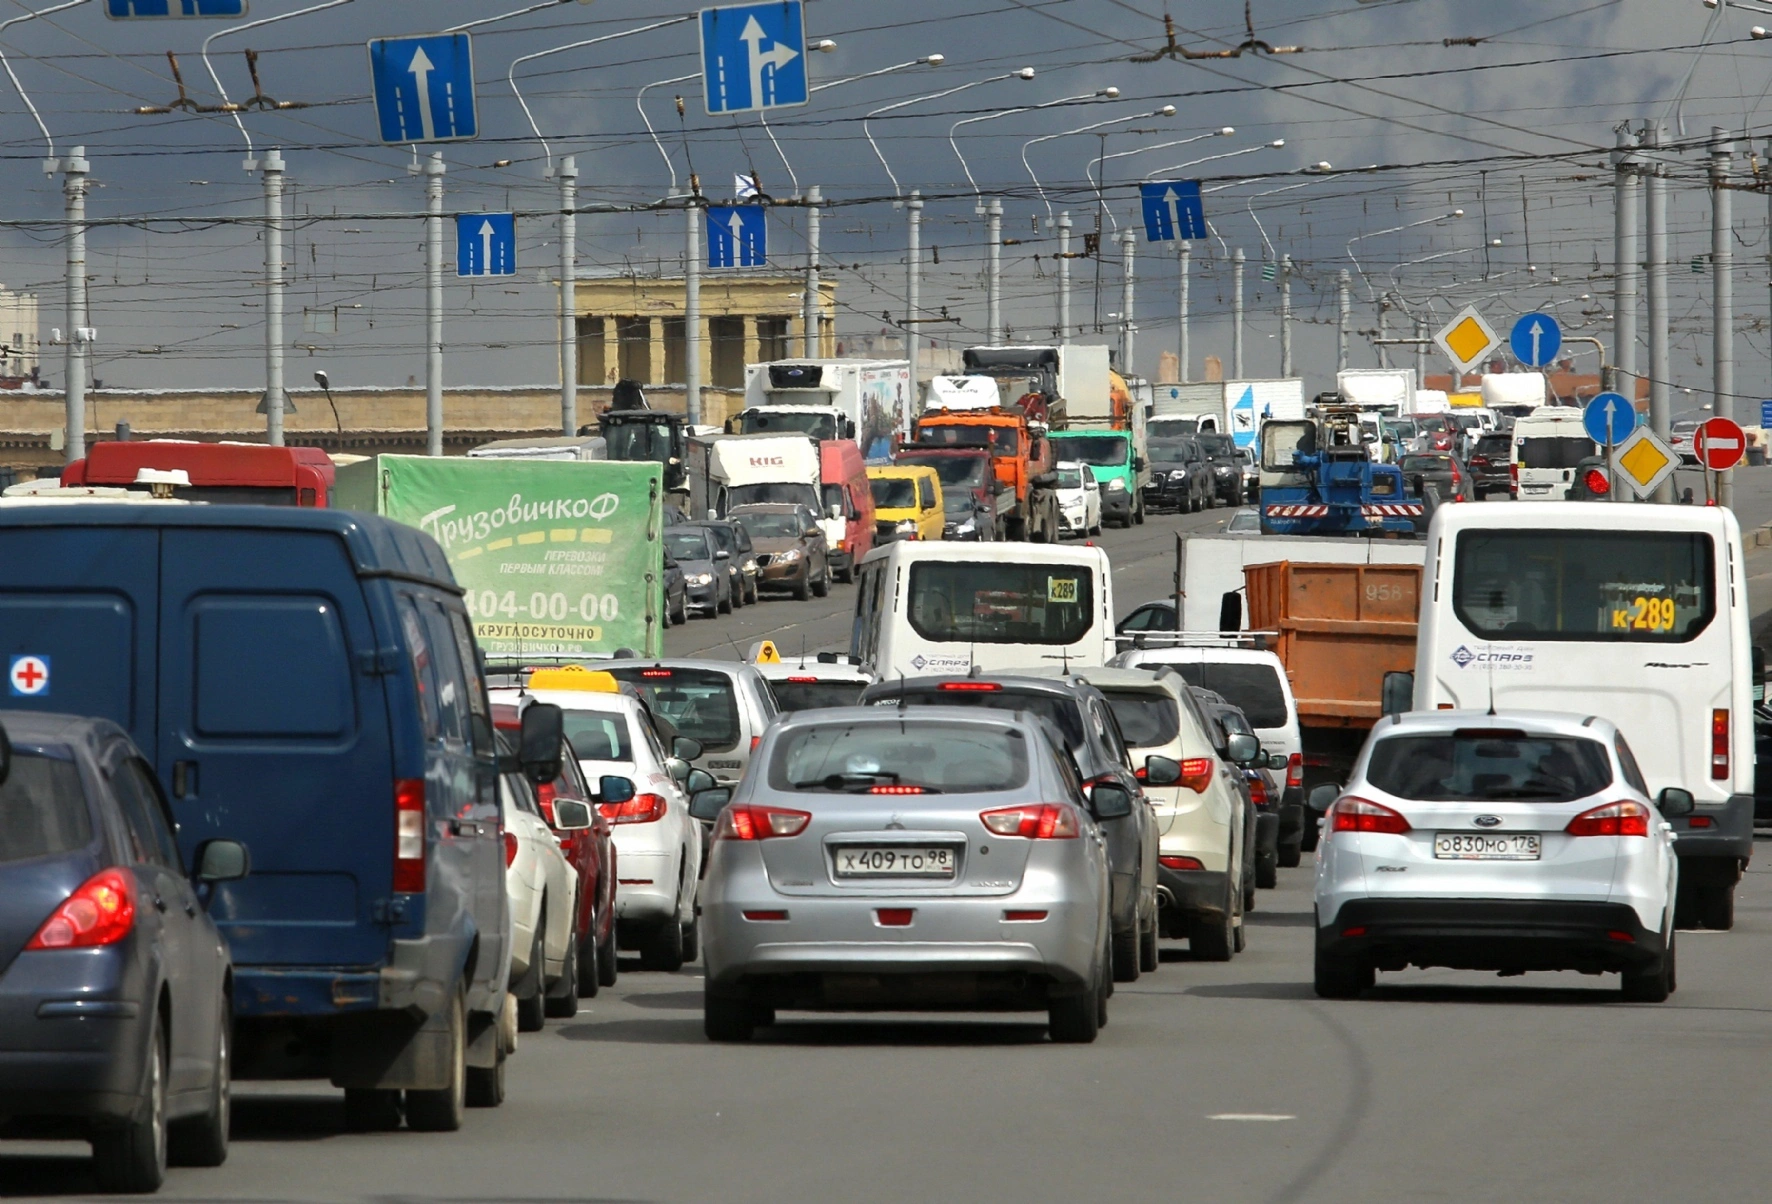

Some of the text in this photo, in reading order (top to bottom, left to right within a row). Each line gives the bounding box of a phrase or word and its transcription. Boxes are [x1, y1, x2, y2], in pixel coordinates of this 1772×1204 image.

[544, 550, 607, 562] ПЕРЕВОЗКИ
[500, 563, 546, 574] ПЕРВЫМ
[478, 624, 595, 639] КРУГЛОСУТОЧНО
